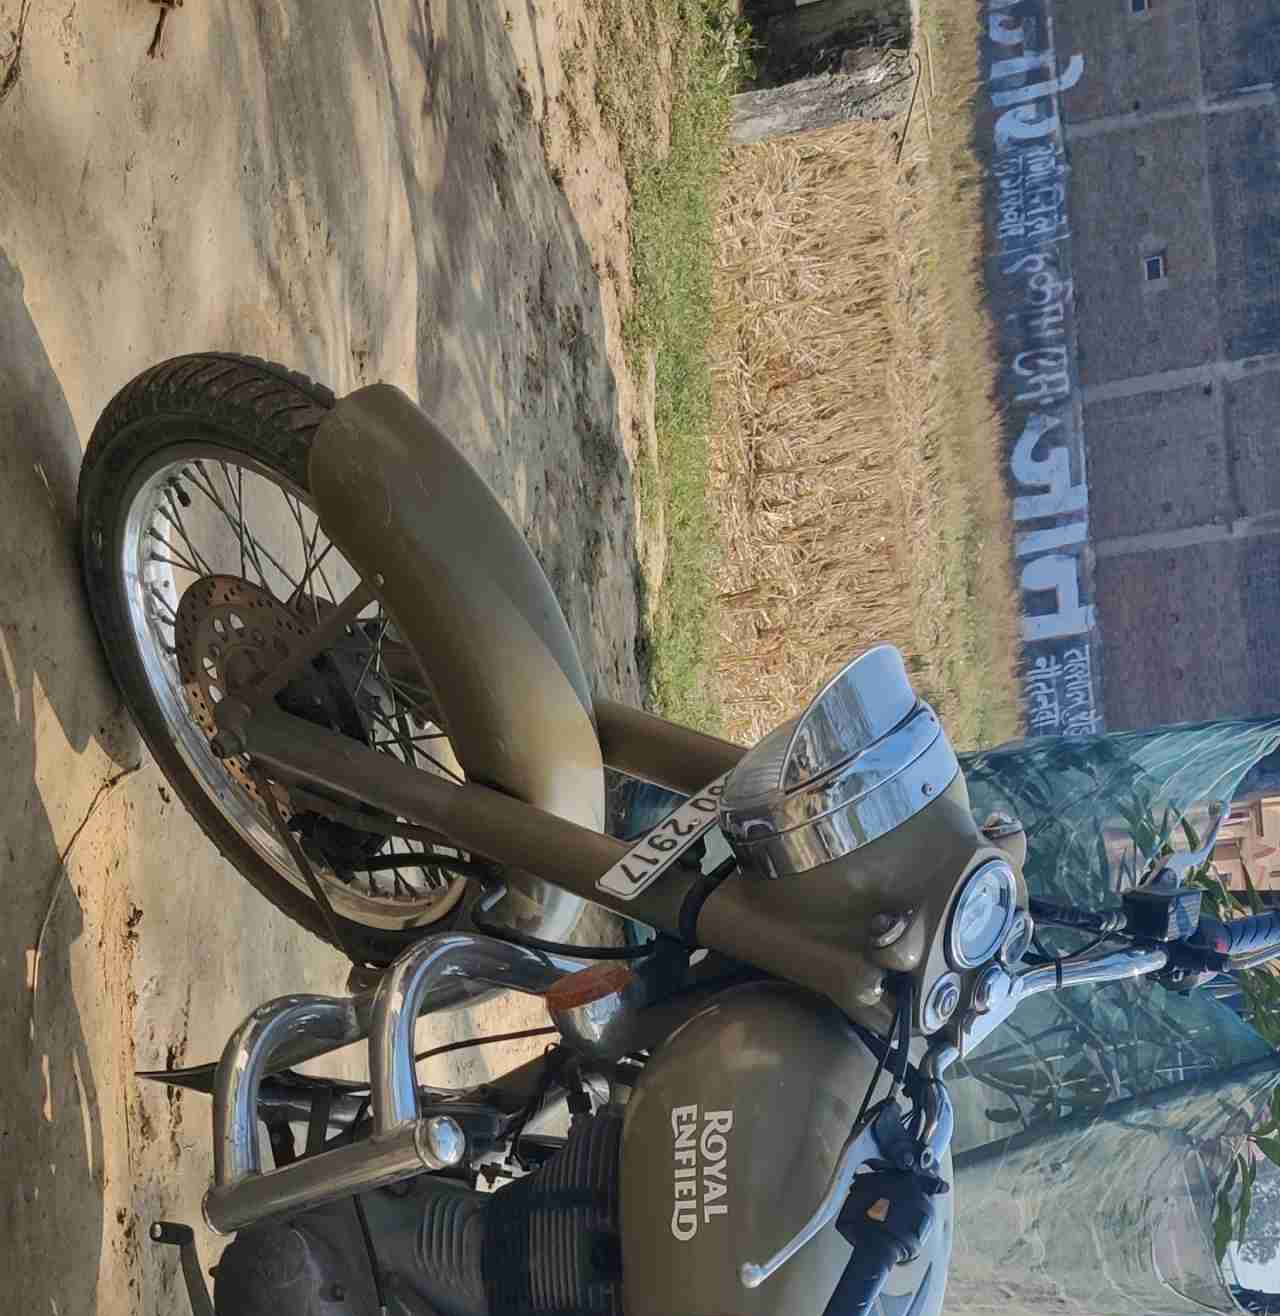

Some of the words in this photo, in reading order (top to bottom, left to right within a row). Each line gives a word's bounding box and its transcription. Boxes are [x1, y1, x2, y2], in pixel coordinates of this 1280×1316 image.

[1011, 413, 1096, 641] जान
[619, 817, 701, 884] 2917
[671, 1103, 698, 1241] ENFIELD
[700, 1110, 734, 1224] ROYAL
